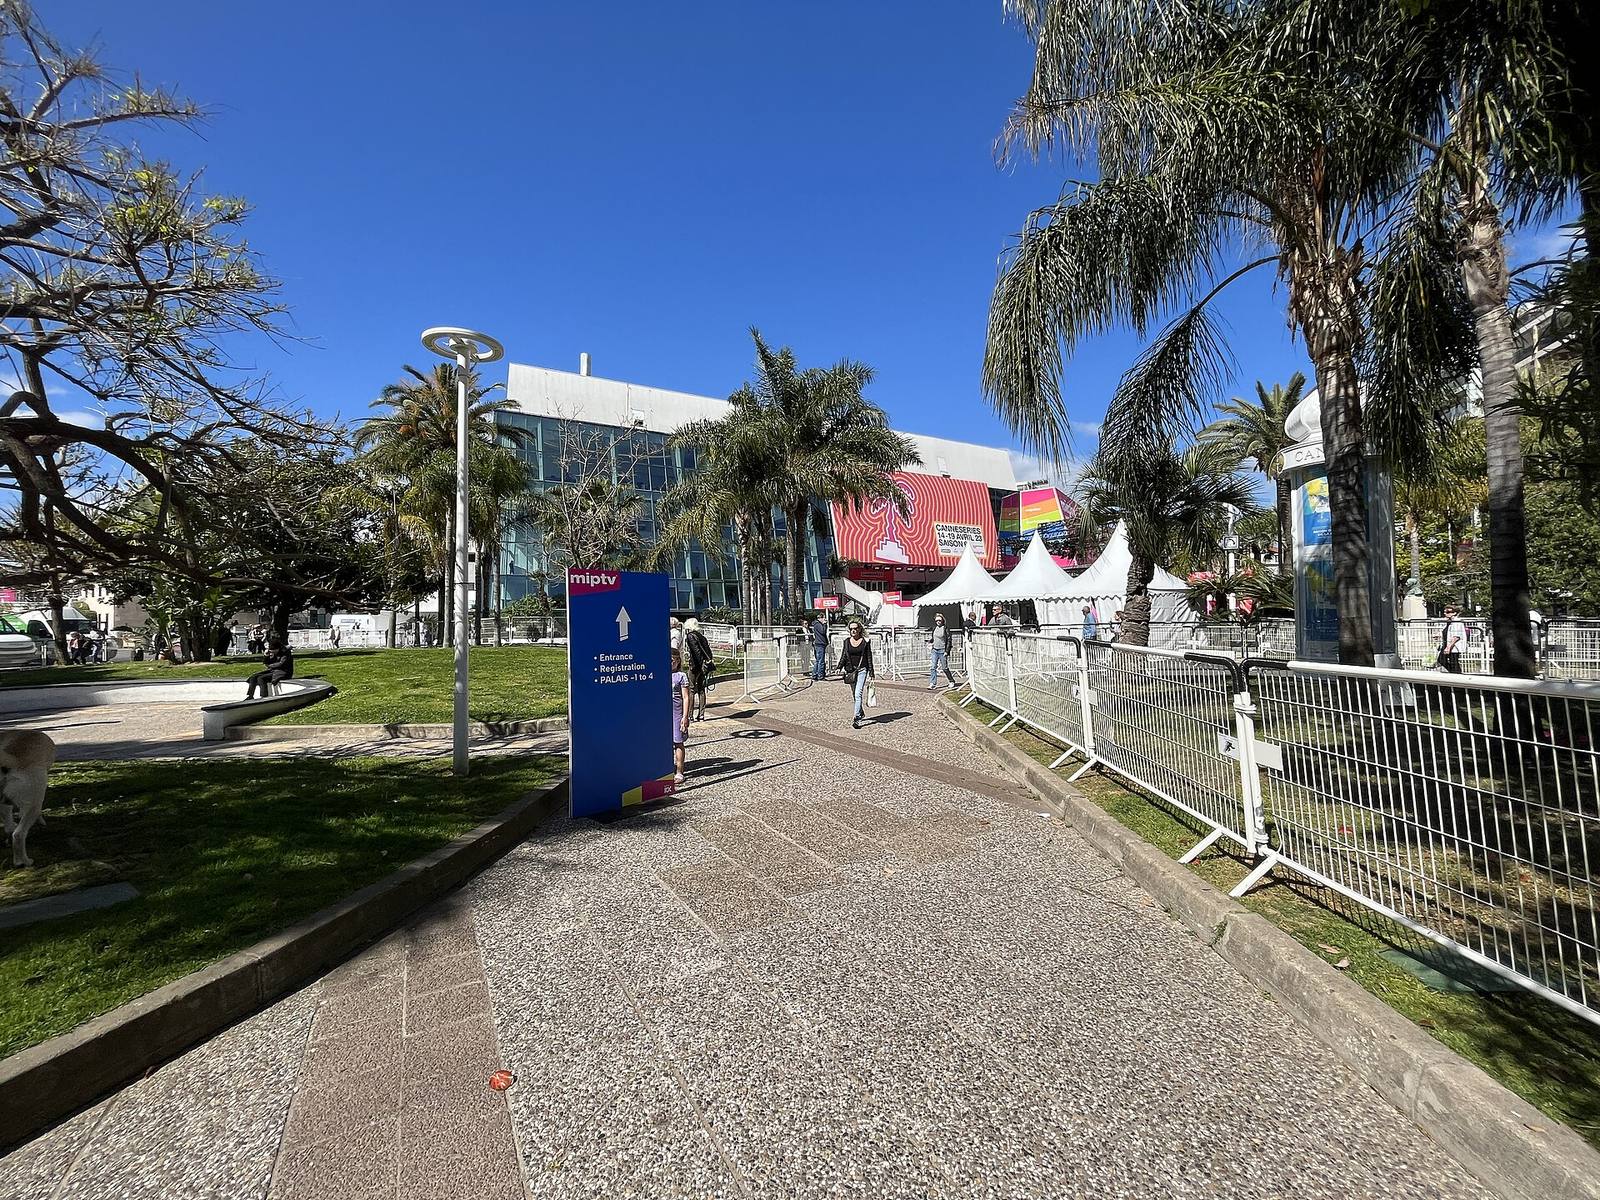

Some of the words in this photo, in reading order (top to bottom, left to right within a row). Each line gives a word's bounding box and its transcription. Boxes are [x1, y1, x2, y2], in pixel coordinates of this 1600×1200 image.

[936, 524, 981, 534] CANNESERIES
[956, 533, 974, 542] AVRIL
[938, 538, 964, 548] SAISON
[570, 572, 616, 587] miptv
[600, 653, 634, 662] Entrance
[600, 662, 646, 674] Registration
[600, 674, 628, 684] PALAIS
